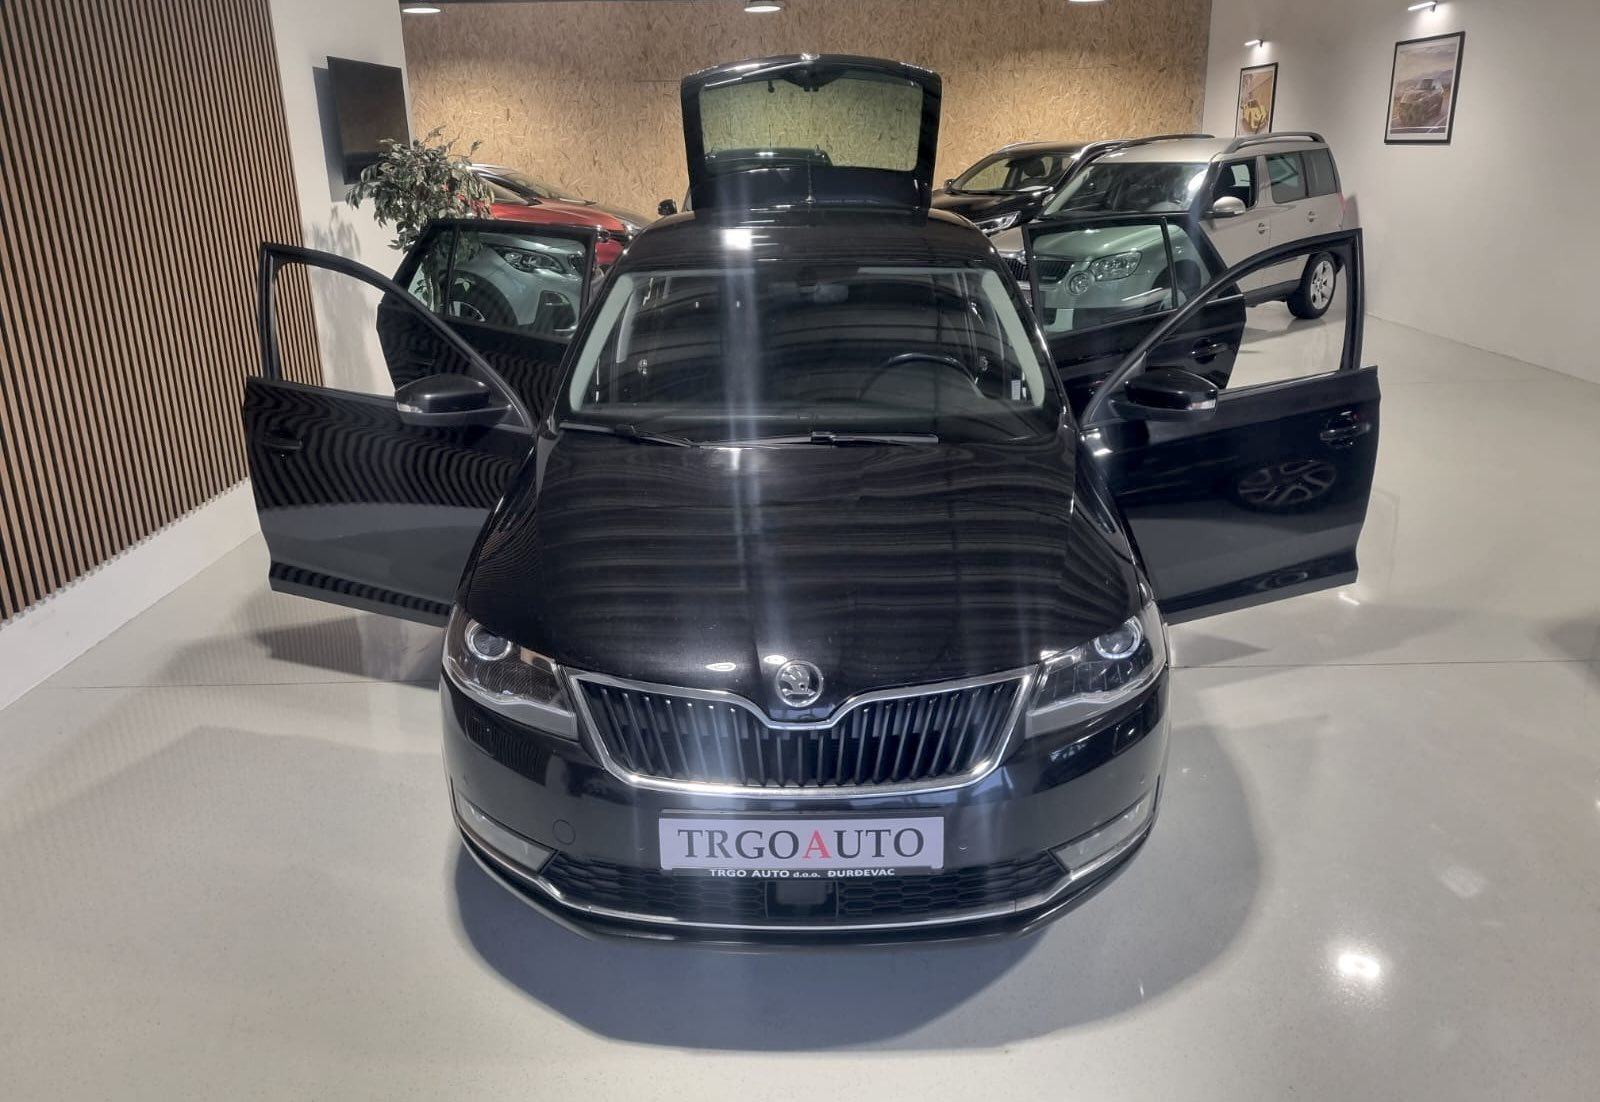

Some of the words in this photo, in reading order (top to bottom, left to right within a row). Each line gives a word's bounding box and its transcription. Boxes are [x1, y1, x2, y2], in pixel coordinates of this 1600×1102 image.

[677, 828, 925, 860] TRGOAUTO
[709, 869, 747, 878] TRGO
[751, 869, 790, 878] AUTO
